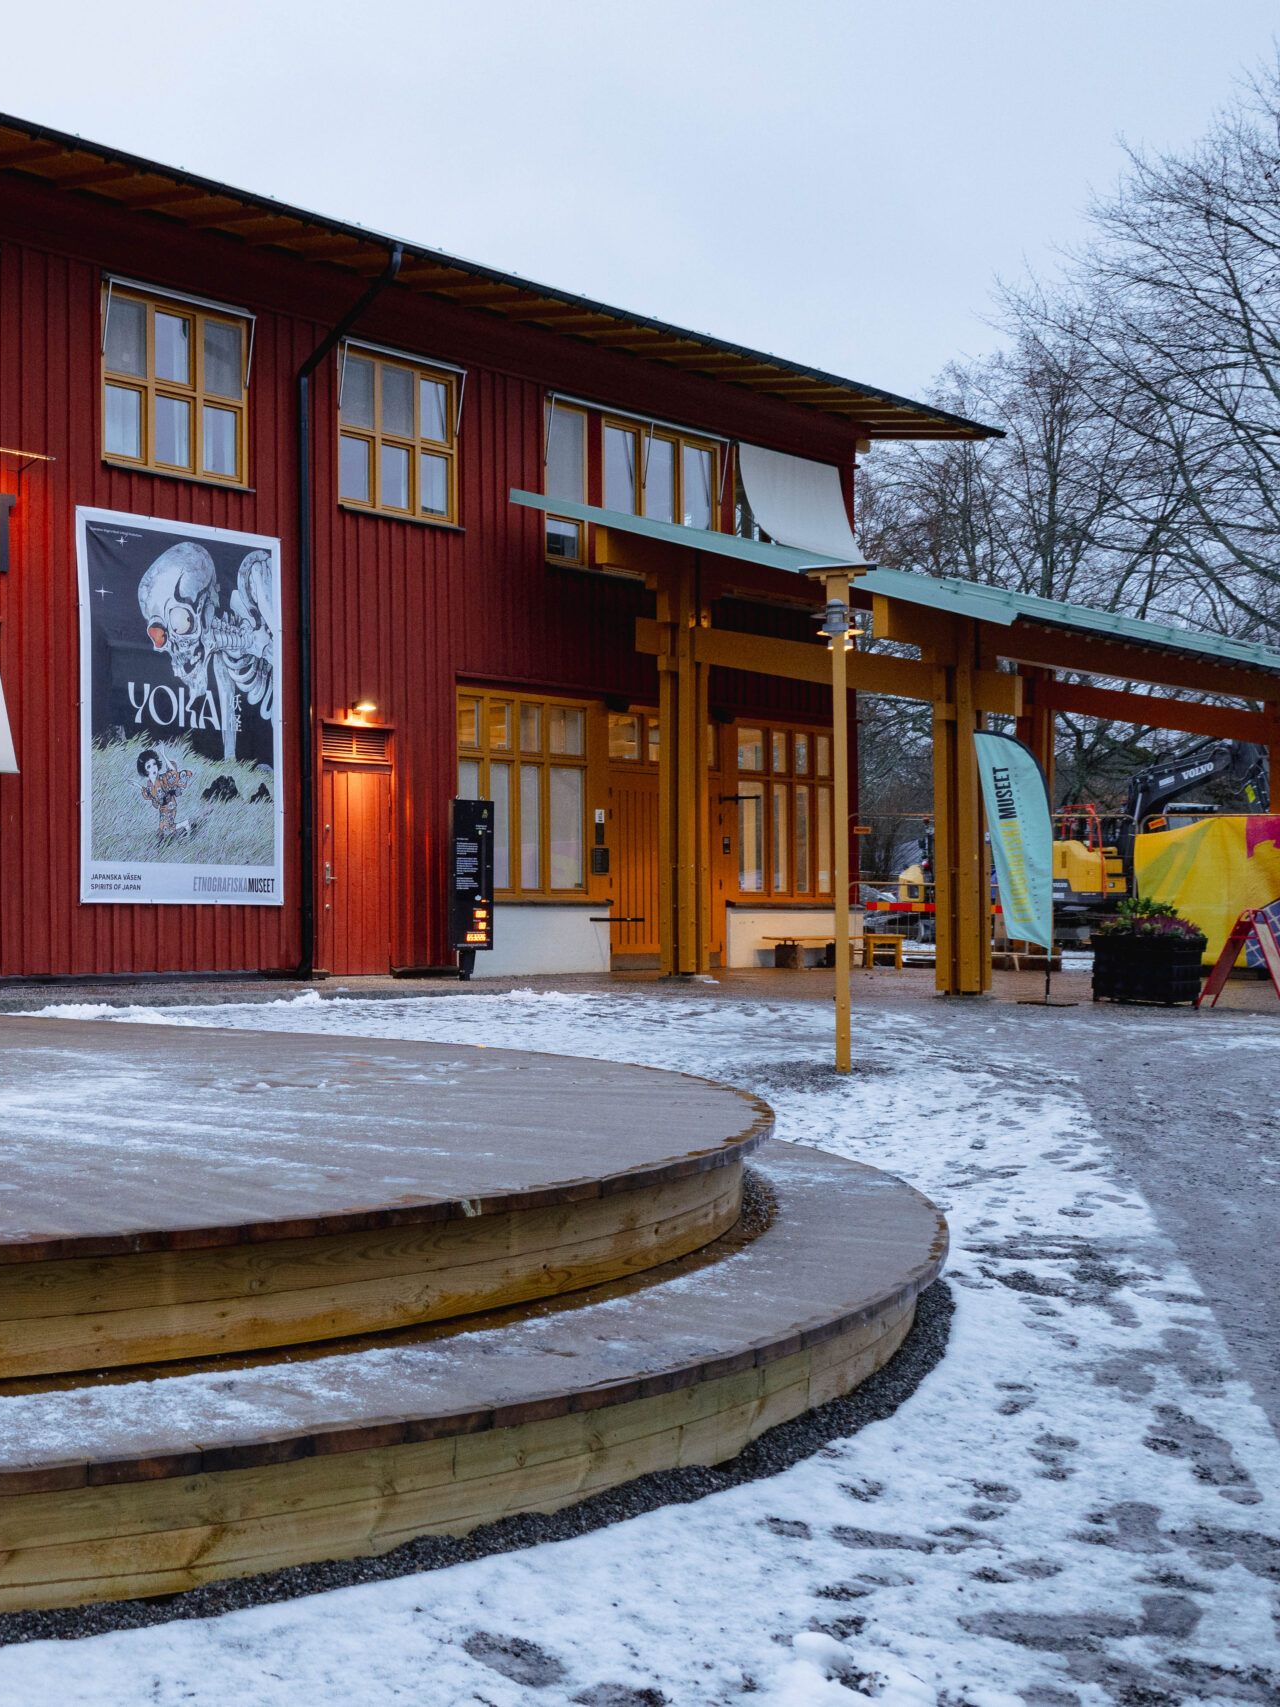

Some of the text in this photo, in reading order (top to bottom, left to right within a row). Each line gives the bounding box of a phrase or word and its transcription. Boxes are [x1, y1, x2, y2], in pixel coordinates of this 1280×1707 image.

[127, 681, 228, 731] YOKAI
[1180, 762, 1215, 780] VOLVO
[90, 872, 142, 881] JAPANSKA VÄSEN
